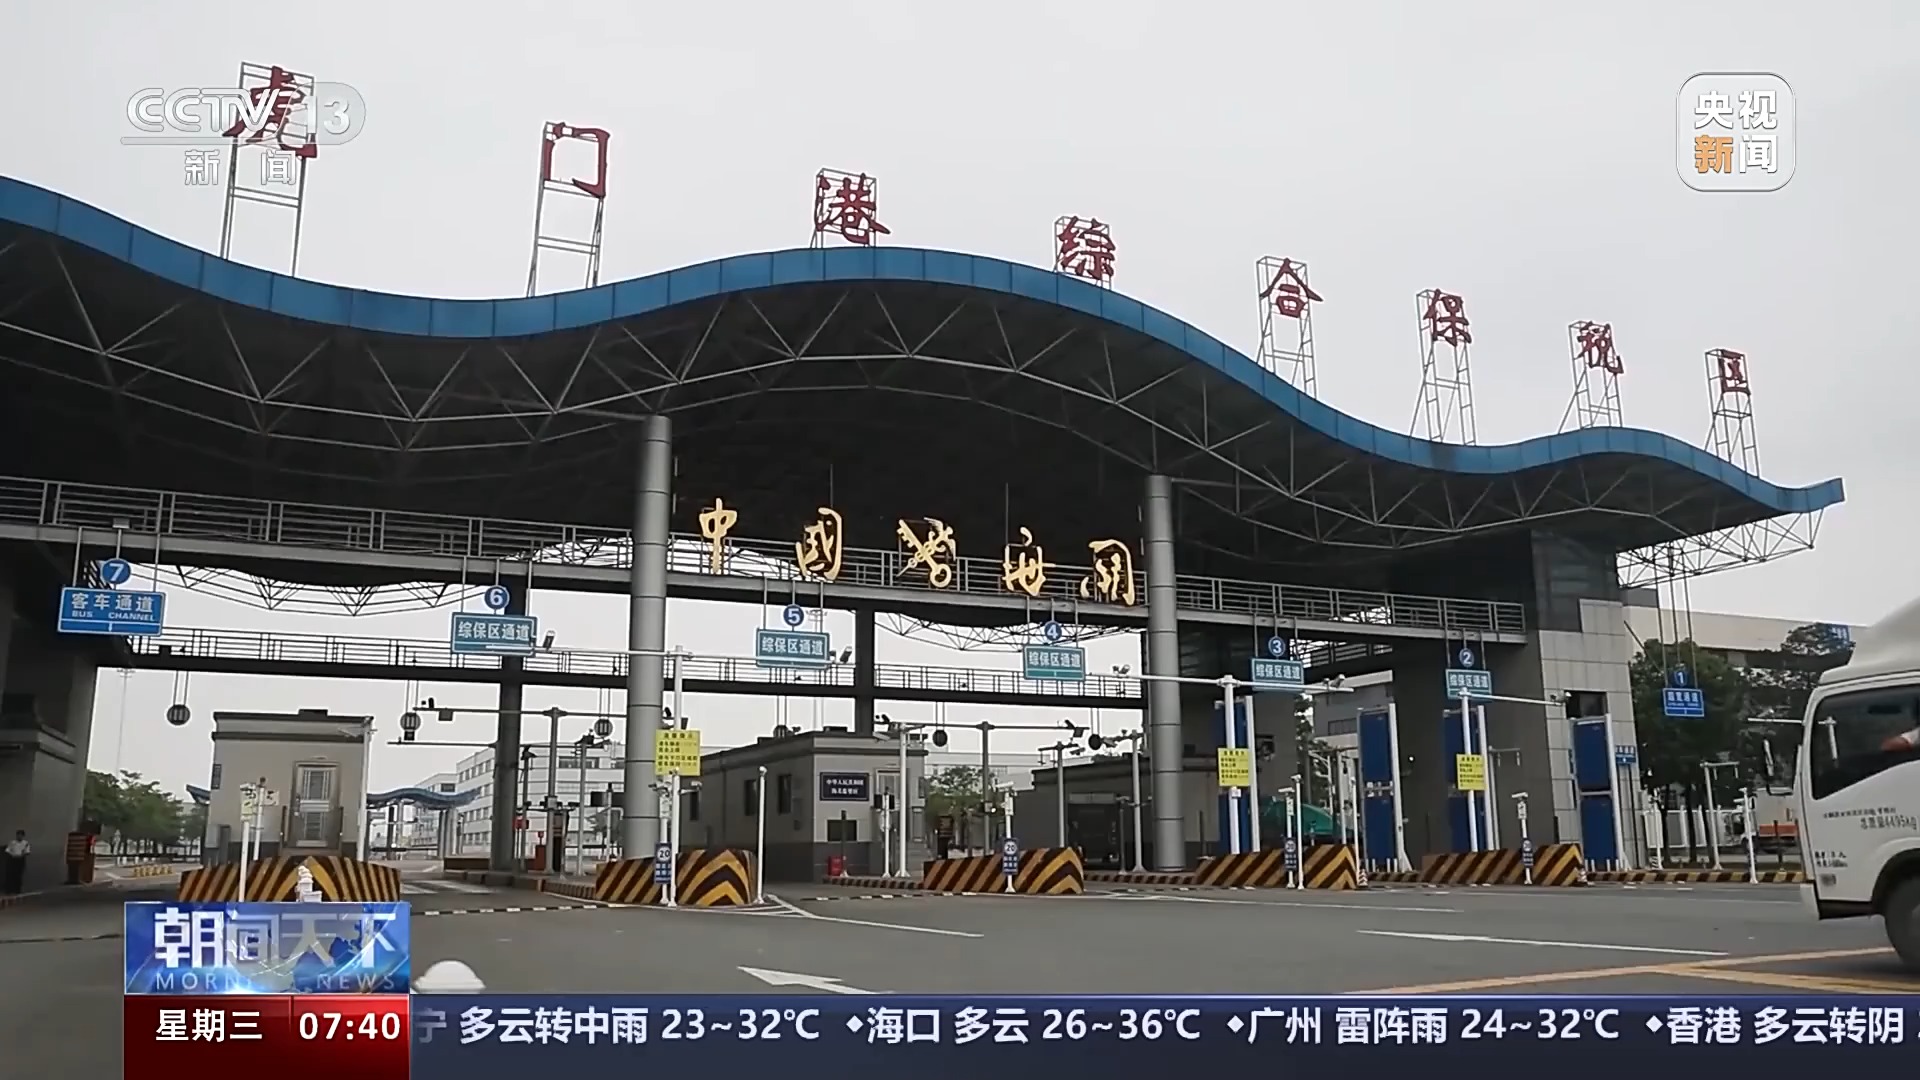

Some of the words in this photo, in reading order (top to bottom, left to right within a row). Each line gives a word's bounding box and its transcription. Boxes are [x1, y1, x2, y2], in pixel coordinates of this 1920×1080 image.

[109, 563, 124, 582] 7
[72, 592, 153, 613] 客车通道
[490, 588, 503, 606] 6
[72, 610, 93, 618] BUS
[108, 612, 155, 622] CHANNEL
[788, 608, 800, 624] 5
[458, 621, 530, 641] 综保区通道
[1047, 624, 1058, 639] 4
[762, 637, 823, 656] 综保区通道
[1272, 640, 1282, 654] 3
[1463, 652, 1472, 665] 2
